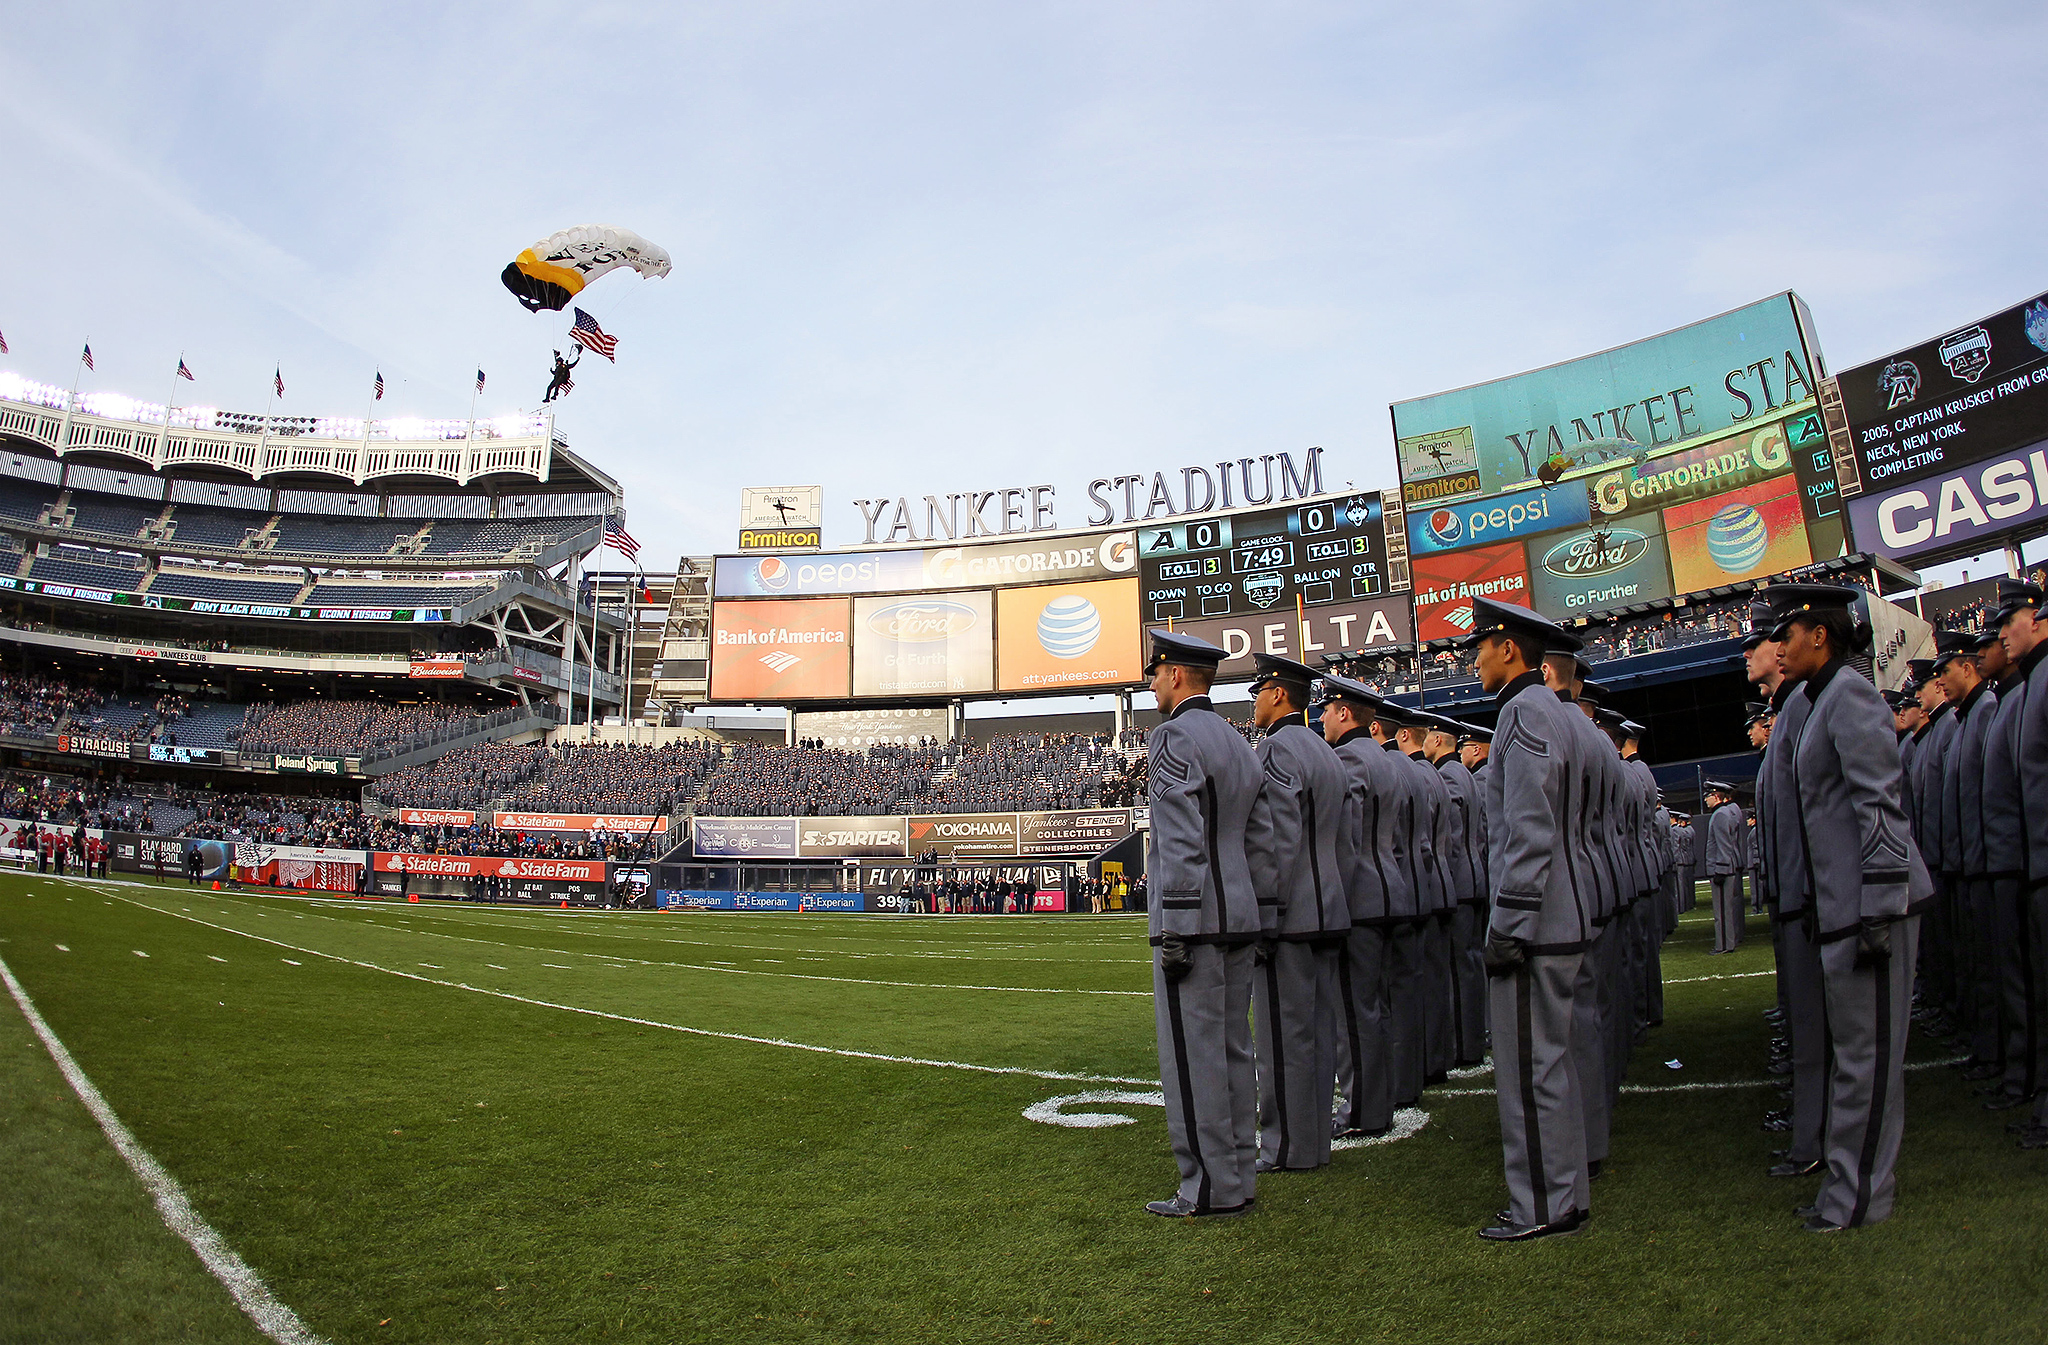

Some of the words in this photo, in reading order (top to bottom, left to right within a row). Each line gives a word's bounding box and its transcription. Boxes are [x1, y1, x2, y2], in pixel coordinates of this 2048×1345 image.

[1862, 424, 1894, 444] 2005,
[1894, 406, 1943, 433] CAPTAIN
[1945, 387, 1996, 416] KRUSKEY
[1997, 375, 2030, 398] FROM
[2031, 366, 2048, 384] GR
[1505, 386, 1700, 479] YANKEE
[1866, 442, 1901, 463] NECK,
[1902, 432, 1928, 452] NEW
[1931, 420, 1966, 442] YORK.
[1413, 463, 1438, 472] AMERICA'
[1444, 459, 1464, 467] WATCH
[1870, 447, 1944, 480] COMPLETING
[1630, 449, 1750, 498] GATORADE
[852, 483, 1057, 544] YANKEE
[1087, 445, 1324, 526] STADIUM
[1404, 476, 1480, 501] Armitron
[764, 495, 798, 503] Armitron
[1308, 508, 1324, 530] 0
[1469, 493, 1550, 539] pepsi
[741, 531, 818, 547] Armitron
[1196, 526, 1212, 546] 0
[1241, 540, 1260, 548] GAME
[1261, 536, 1284, 544] CLOCK
[1311, 544, 1346, 558] T.O.L.
[1354, 538, 1365, 552] 3
[968, 548, 1096, 576] GATORADE
[1242, 548, 1284, 568] 7:49
[798, 556, 880, 589] pepsi
[1163, 564, 1198, 577] T.O.L.
[1206, 560, 1216, 574] 3
[1294, 571, 1320, 584] BALL
[1322, 568, 1340, 580] ON
[1352, 562, 1376, 576] QTR
[44, 584, 73, 596] UCONN
[74, 590, 112, 602] HUSKIES
[1149, 588, 1186, 600] DOWN
[1196, 585, 1212, 596] TO
[1214, 582, 1232, 593] GO
[1362, 578, 1370, 592] 1
[1415, 587, 1440, 606] nk
[1440, 584, 1458, 600] of
[1458, 575, 1524, 599] America
[1565, 593, 1586, 608] Go
[1588, 582, 1638, 604] Further
[191, 601, 220, 612] ARMY
[219, 604, 250, 614] BLACK
[249, 606, 292, 616] KNIGHTS
[320, 609, 350, 618] UCONN
[351, 610, 392, 620] HUSKIES
[889, 606, 955, 634] Ford
[717, 628, 758, 645] Bank
[759, 628, 776, 644] of
[777, 628, 844, 644] America
[1222, 610, 1397, 661] DELTA
[136, 648, 158, 658] Audi
[160, 651, 188, 660] YANKEES
[190, 654, 206, 662] CLUB
[884, 654, 904, 667] Go
[908, 652, 948, 666] Furth
[410, 665, 462, 676] Budweiser
[1022, 669, 1118, 685] att.yankees.com
[879, 679, 946, 691] tristateford.com
[854, 722, 874, 734] York
[874, 720, 902, 734] Yankees
[70, 736, 131, 753] SYRACUSE
[150, 754, 190, 764] COMPLETING
[275, 754, 306, 770] Poland
[306, 756, 338, 774] Spring
[934, 823, 1014, 837] YOKOHAMA
[1023, 814, 1068, 834] Yankees
[1076, 816, 1125, 826] STEINER
[827, 830, 901, 846] STARTER
[1036, 828, 1112, 839] COLLECTIBLES
[141, 840, 159, 850] PLAY
[160, 842, 184, 854] HARD.
[141, 850, 155, 861] STA
[1023, 843, 1111, 852] STEINERSPORTS.C
[869, 868, 898, 886] FLY
[752, 896, 788, 908] Experian
[817, 896, 854, 908] Experian
